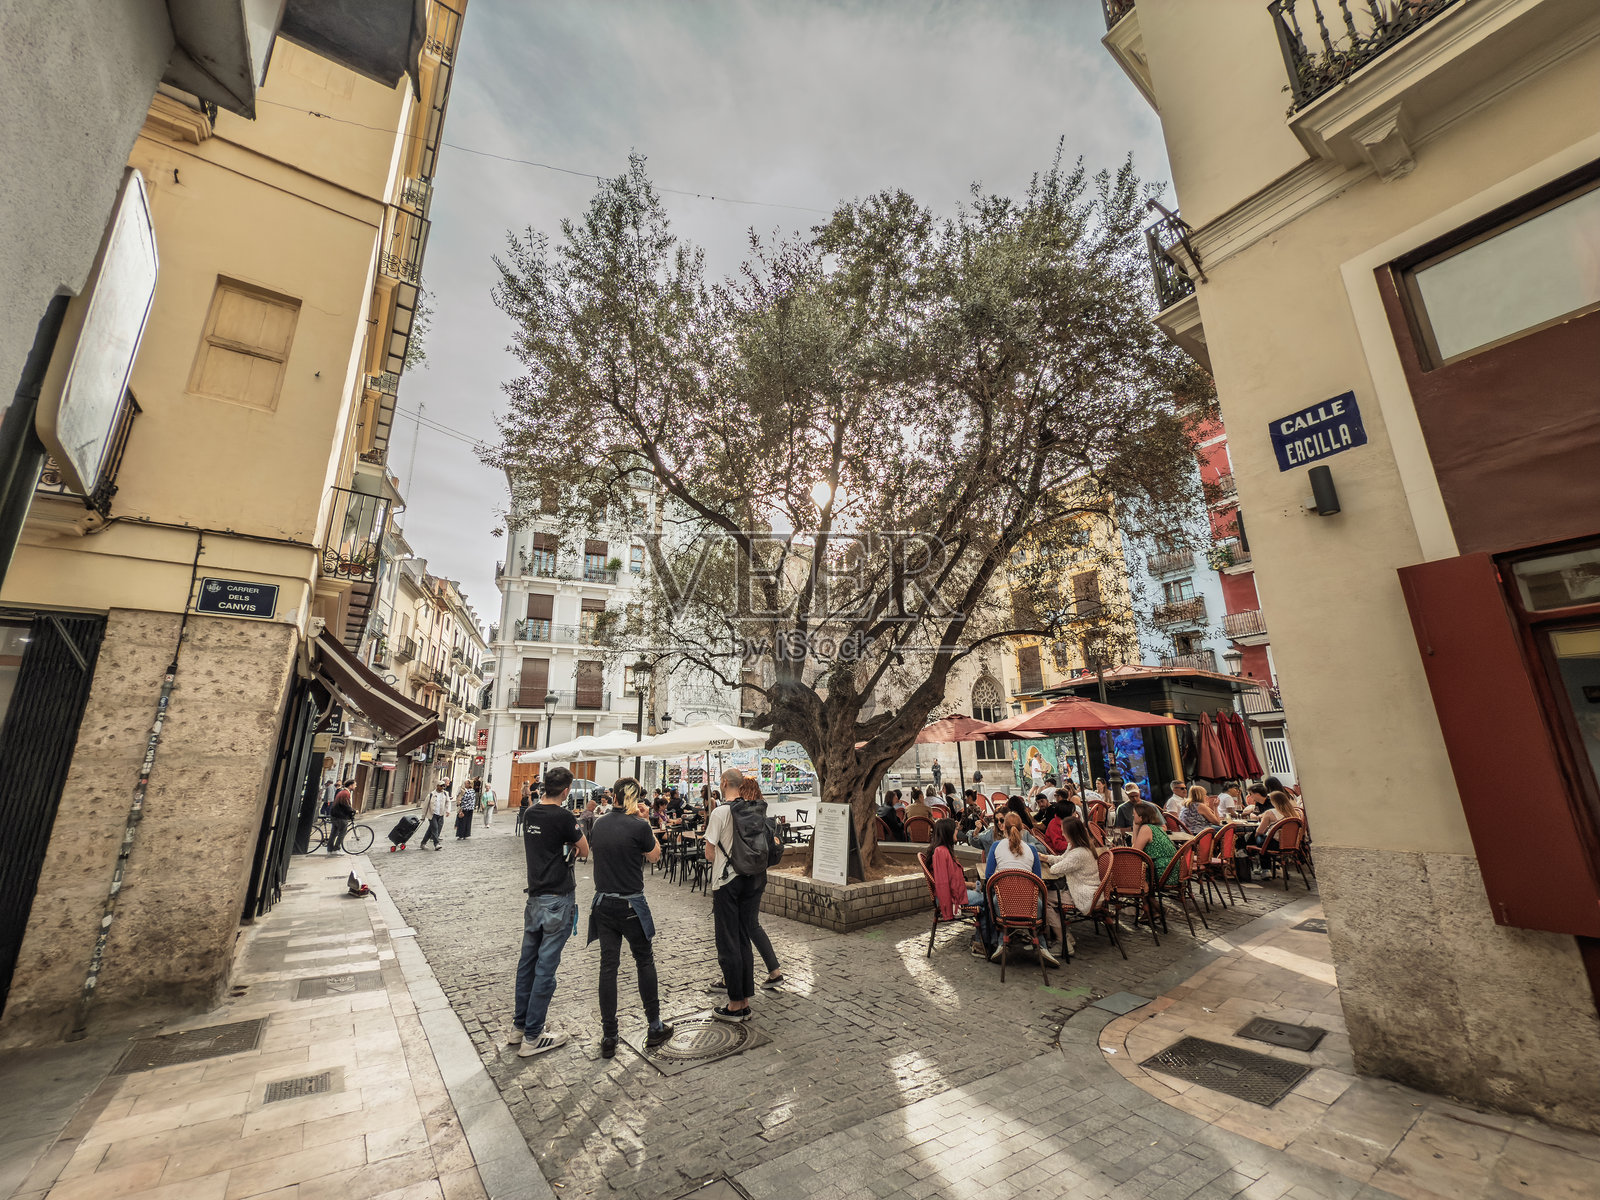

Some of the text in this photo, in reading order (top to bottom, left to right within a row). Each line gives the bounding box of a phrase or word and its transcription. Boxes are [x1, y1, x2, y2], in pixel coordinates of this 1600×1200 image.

[1280, 400, 1346, 435] CALLE
[1285, 423, 1352, 465] ERCILLA
[226, 585, 260, 594] CARRER
[218, 601, 257, 612] CANVIS
